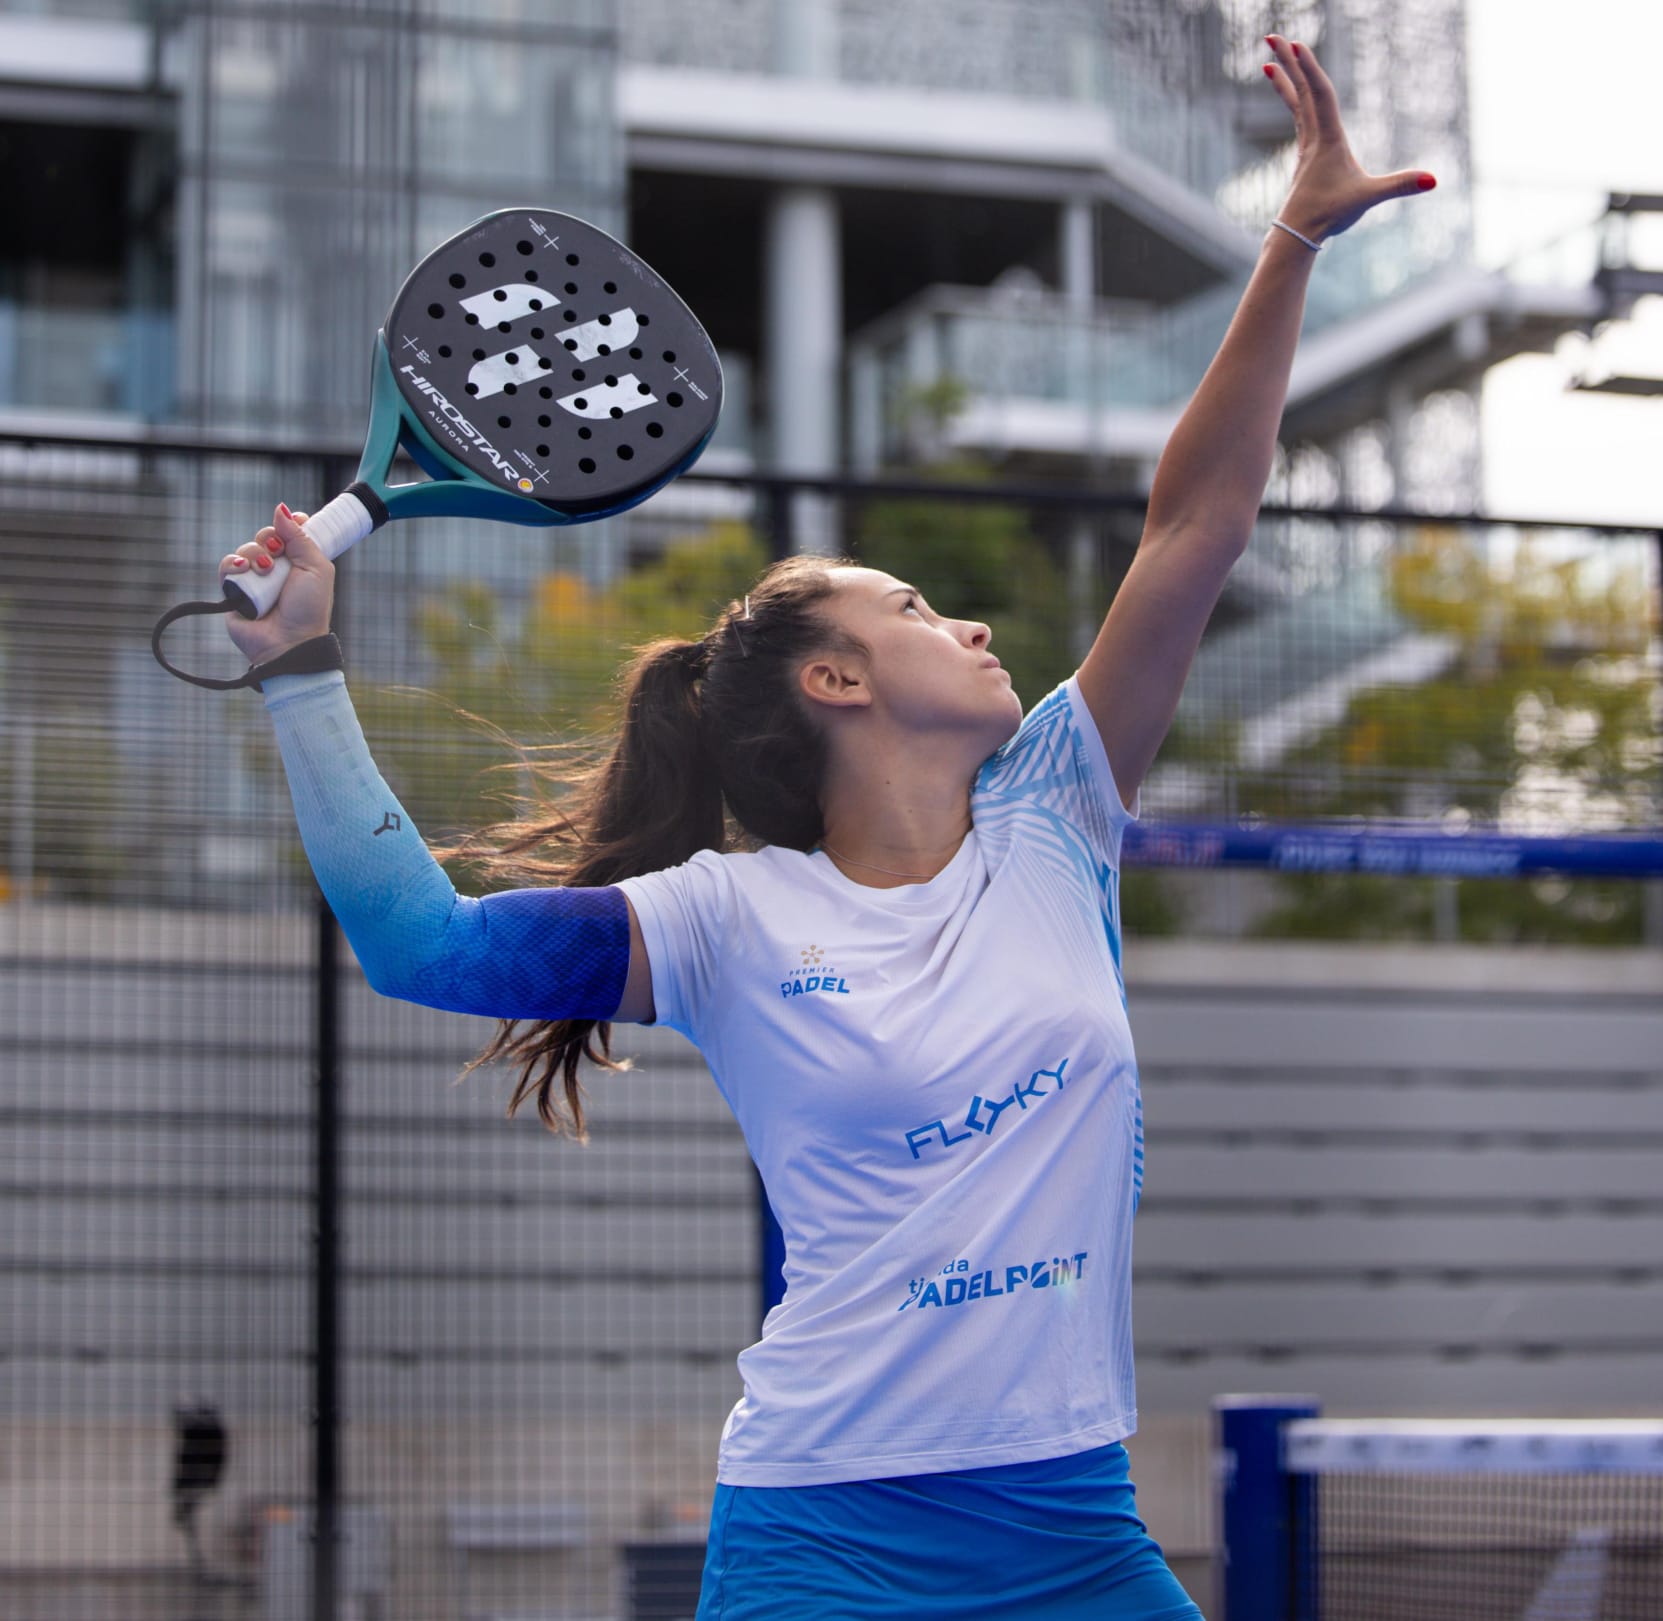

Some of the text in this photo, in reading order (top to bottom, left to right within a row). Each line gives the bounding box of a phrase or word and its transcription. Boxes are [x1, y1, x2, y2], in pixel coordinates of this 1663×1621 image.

[400, 365, 520, 480] HIROSTAR
[428, 410, 469, 452] AURORA
[780, 976, 850, 998] PADEL
[789, 966, 835, 976] PREMIER
[908, 1258, 969, 1294] tida
